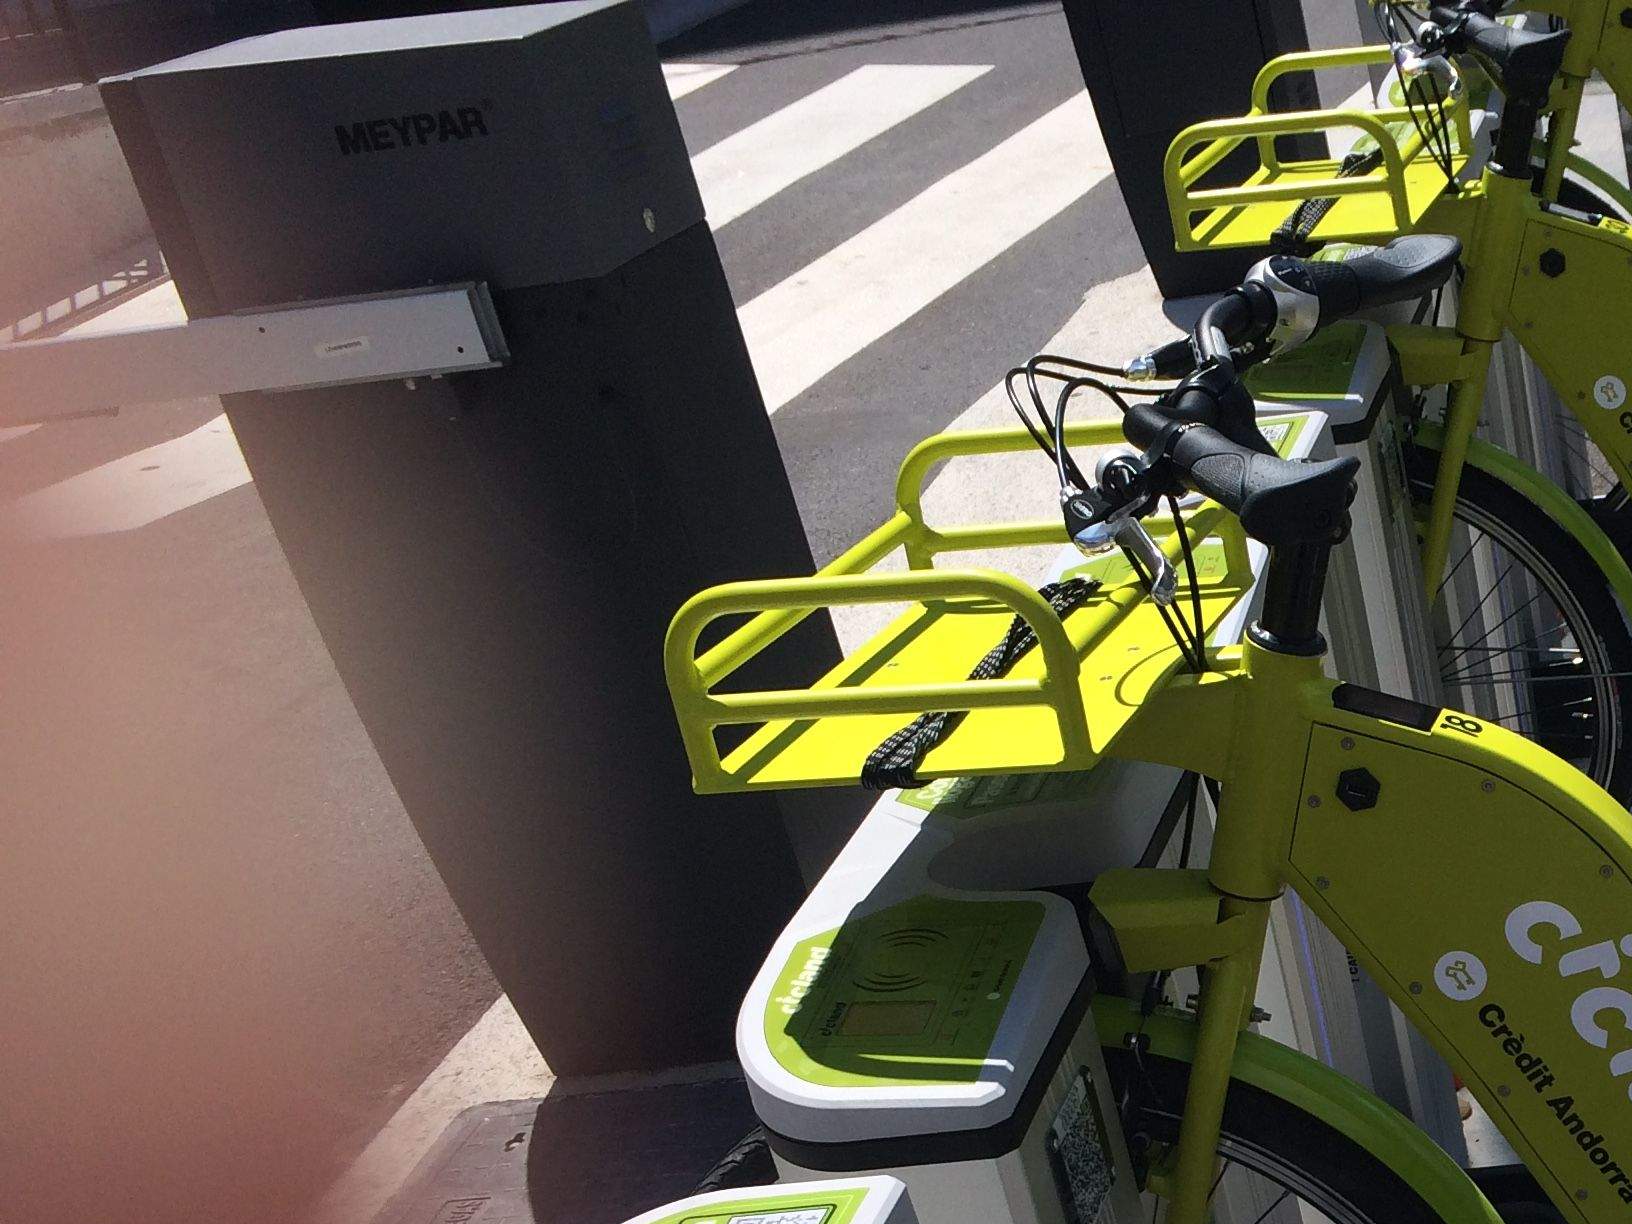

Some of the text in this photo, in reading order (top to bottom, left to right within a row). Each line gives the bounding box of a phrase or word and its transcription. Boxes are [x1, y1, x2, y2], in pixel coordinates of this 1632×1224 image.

[334, 106, 489, 155] MEYPAR
[1440, 715, 1483, 738] 18
[1478, 1003, 1554, 1093] Crèdit
